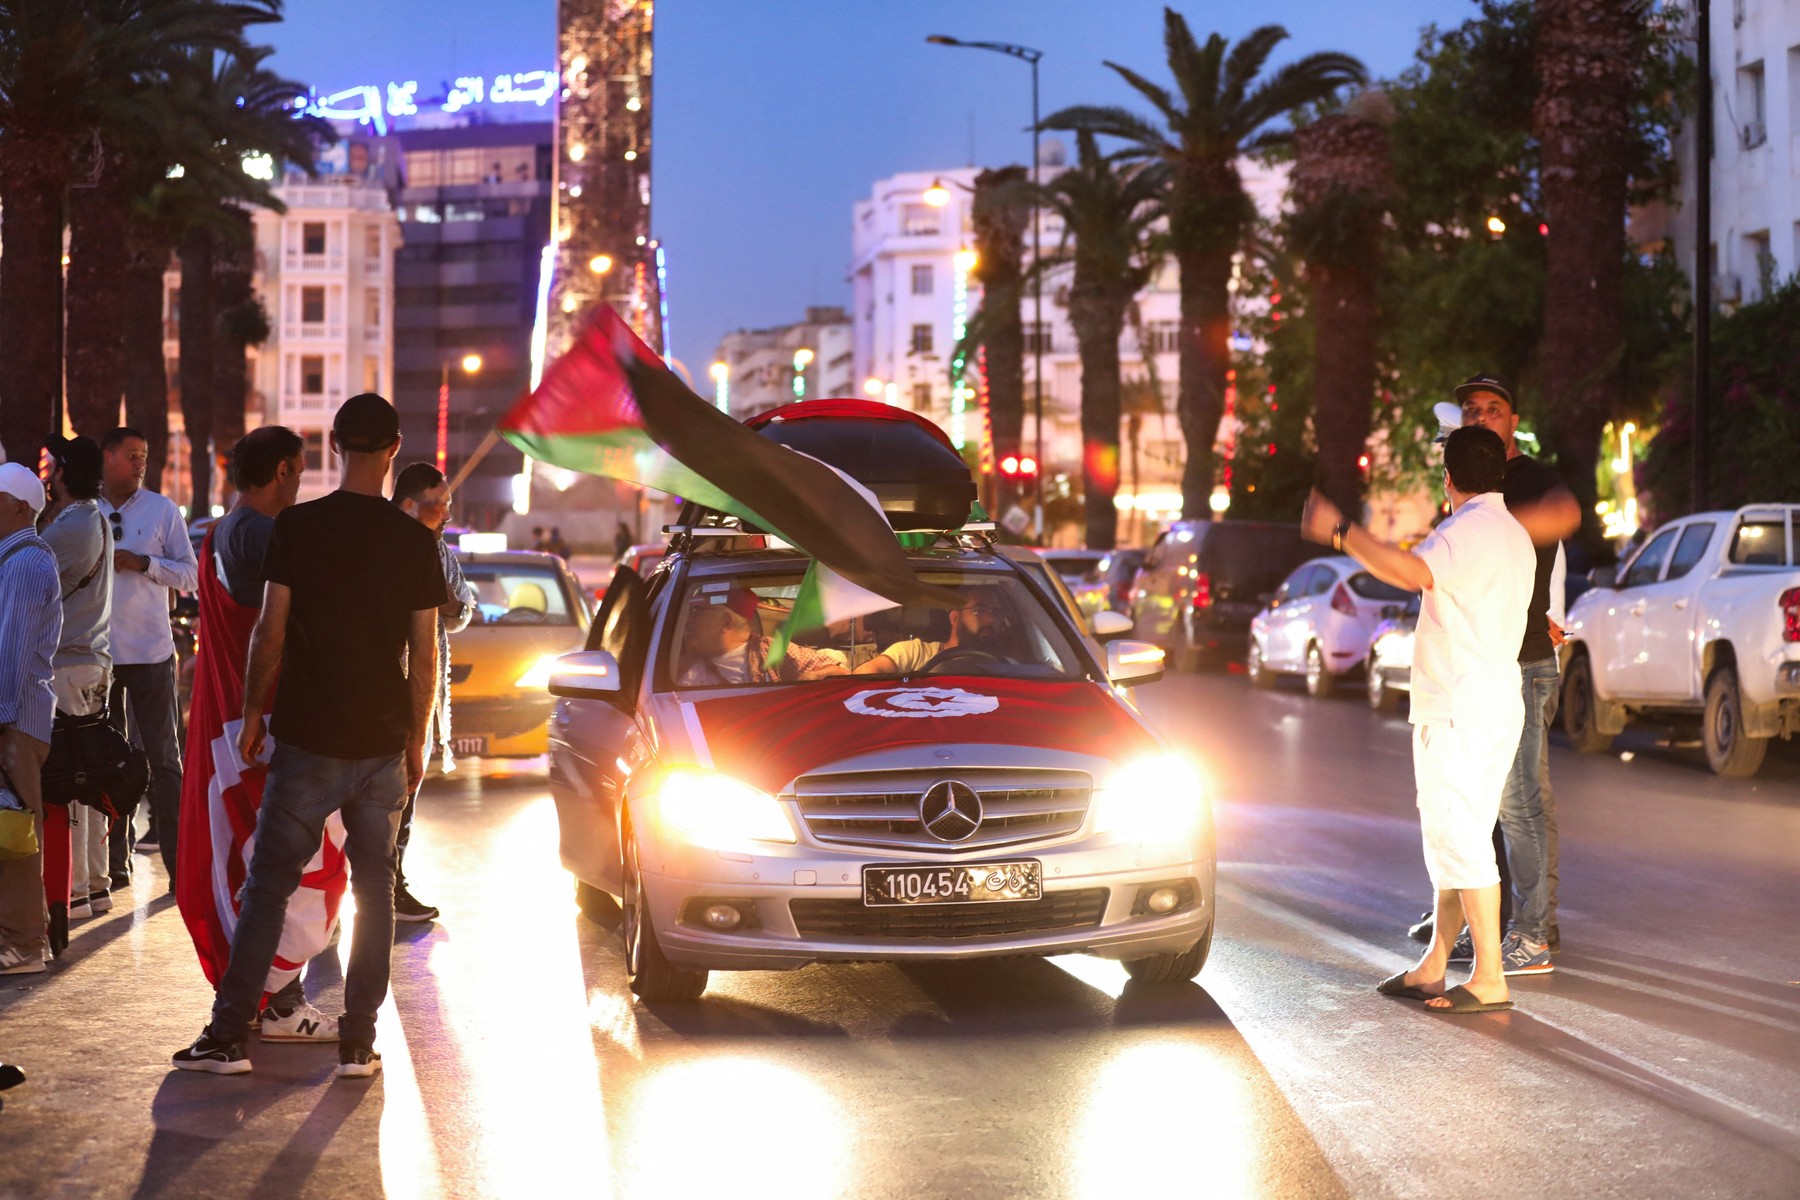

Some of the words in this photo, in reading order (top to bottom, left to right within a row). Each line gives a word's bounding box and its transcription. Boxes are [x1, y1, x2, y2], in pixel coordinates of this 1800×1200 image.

[887, 872, 968, 898] 110454
[1507, 948, 1531, 966] N
[296, 1018, 321, 1036] N
